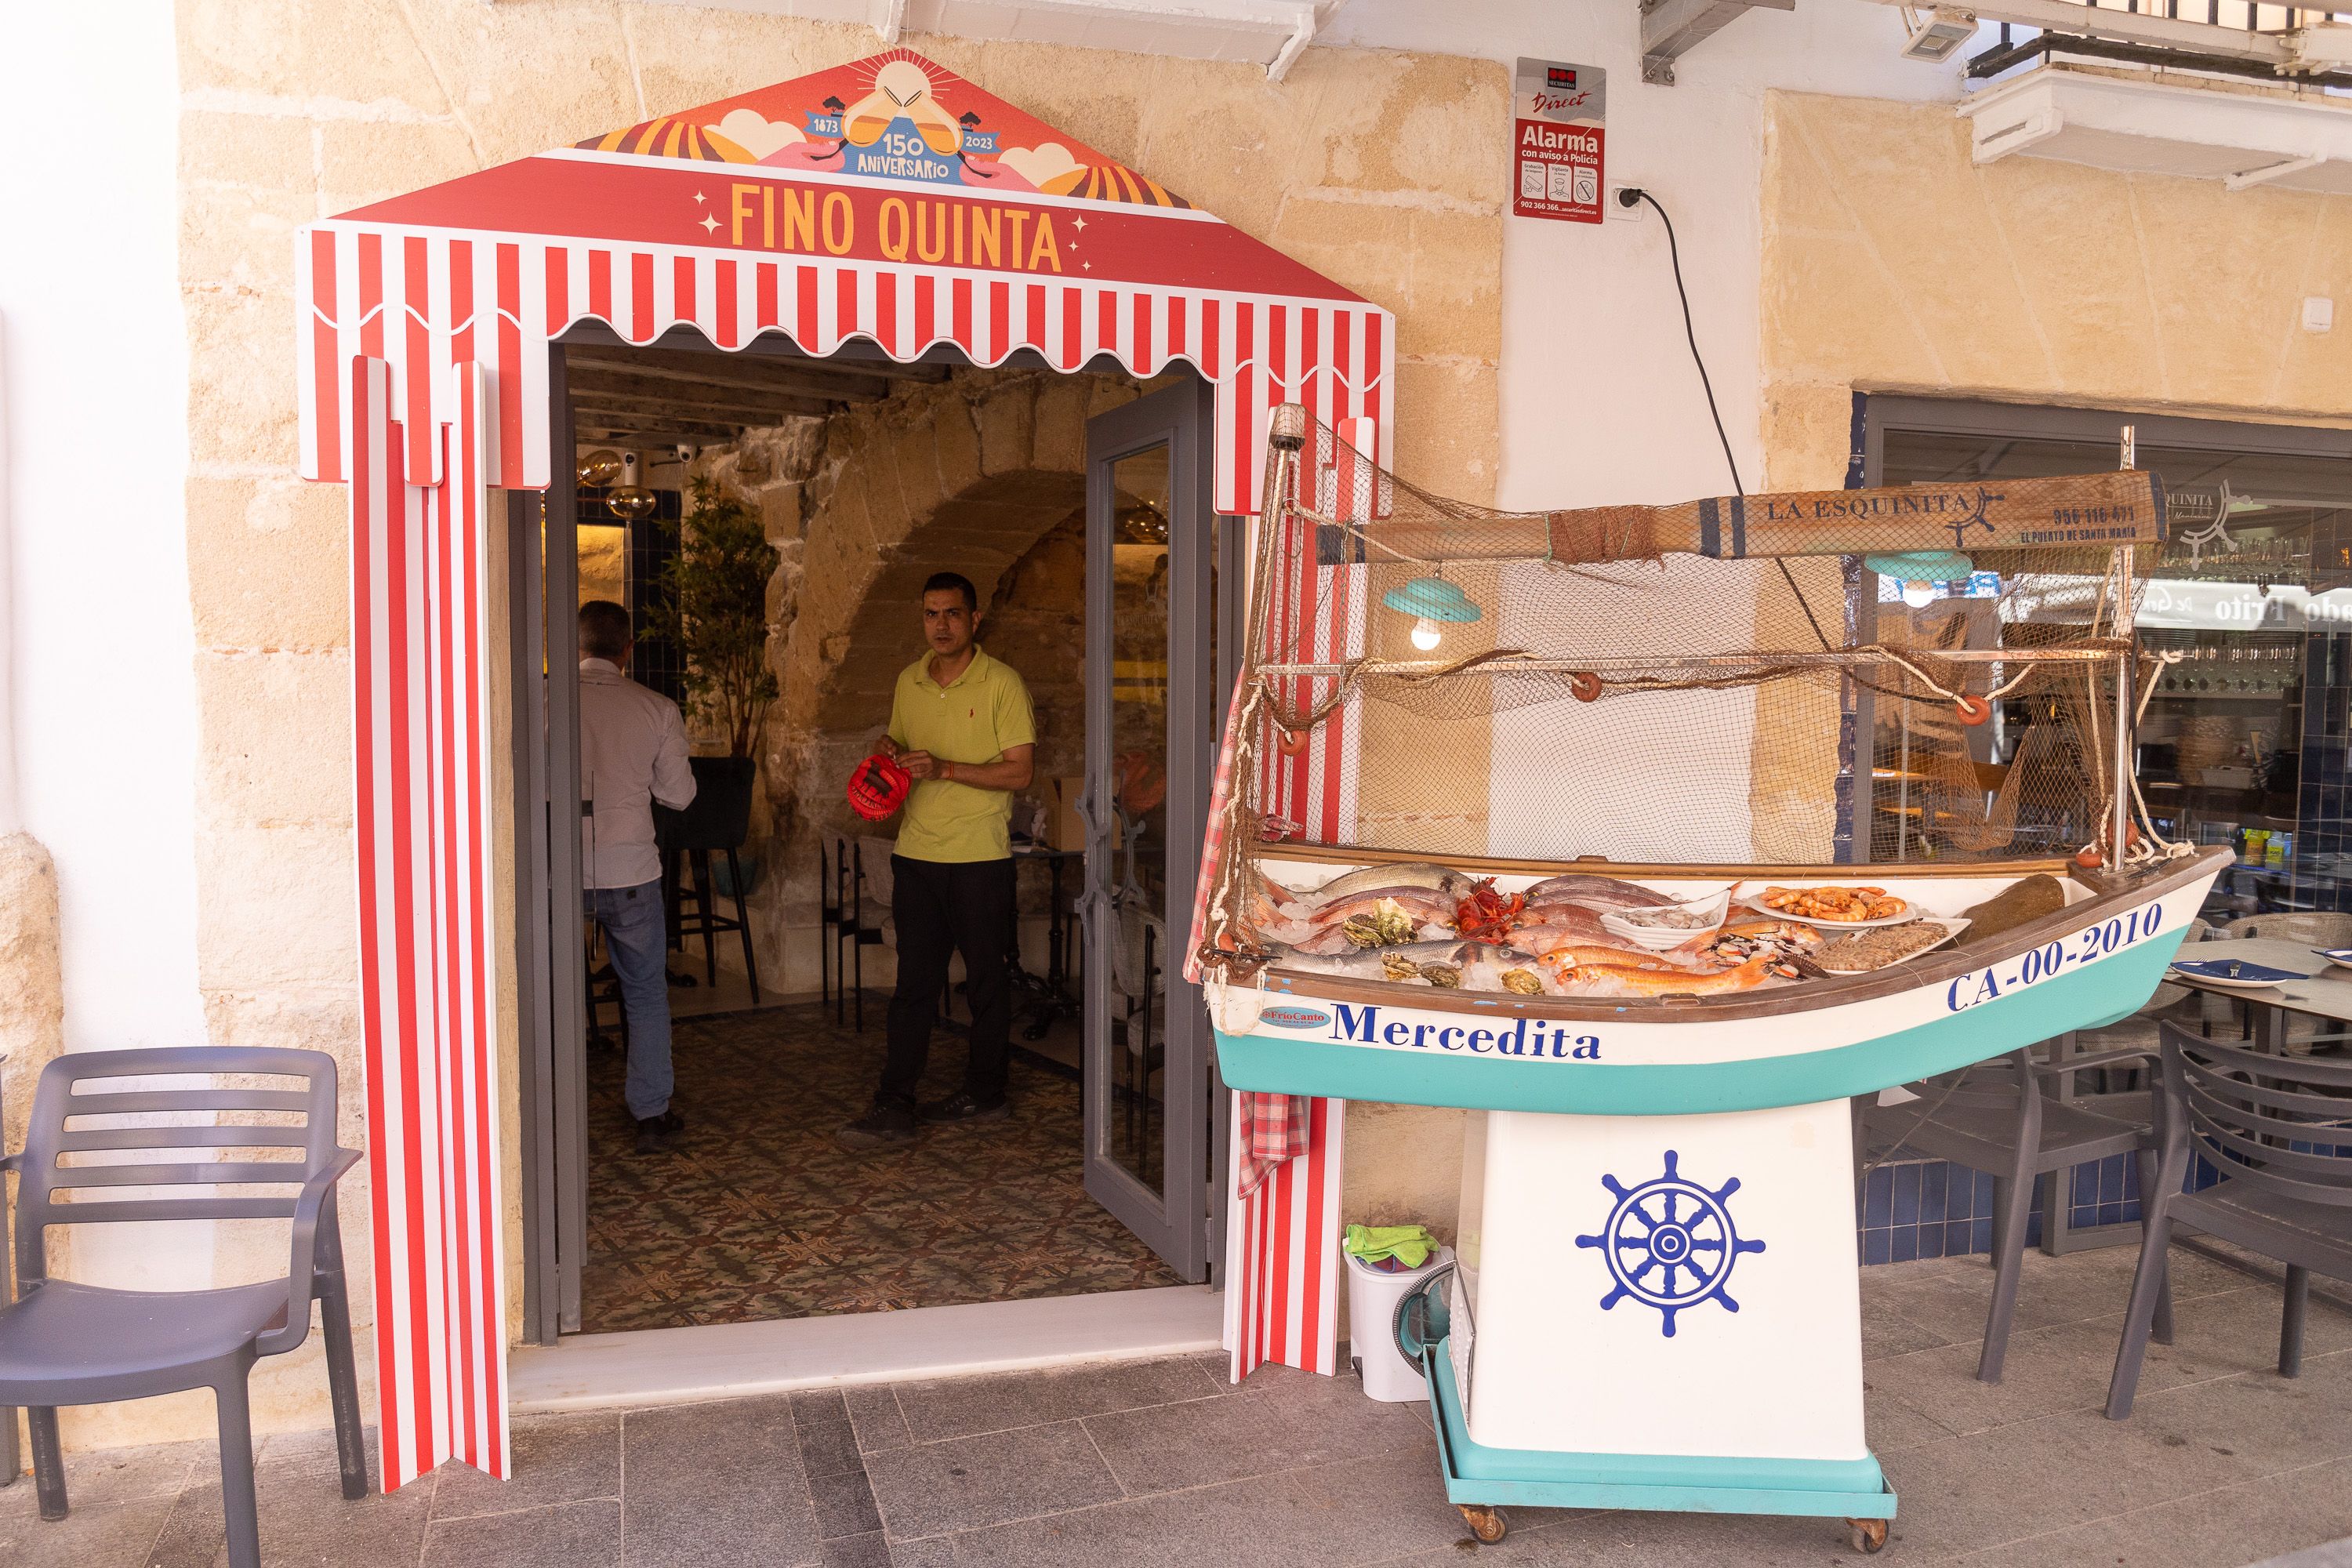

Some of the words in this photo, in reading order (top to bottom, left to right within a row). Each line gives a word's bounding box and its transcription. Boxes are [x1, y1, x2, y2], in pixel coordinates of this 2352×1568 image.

[1531, 91, 1593, 113] Direct
[814, 118, 838, 133] 1873
[883, 133, 924, 157] 150
[965, 136, 993, 150] 2023
[1522, 125, 1598, 154] Alarma
[1522, 149, 1537, 158] con
[1539, 150, 1561, 161] aviso
[1570, 153, 1598, 165] Policía
[731, 183, 855, 256] FINO
[878, 197, 1063, 274] QUINTA
[1767, 501, 1803, 520] LA
[1813, 494, 1971, 520] ESQUINITA
[2020, 532, 2031, 543] EL
[2032, 530, 2064, 543] PUERTO
[2067, 529, 2078, 541] DE
[2079, 528, 2107, 541] SANTA
[1947, 903, 2161, 1011] CA-00-2010
[1328, 1003, 1602, 1060] Mercedita
